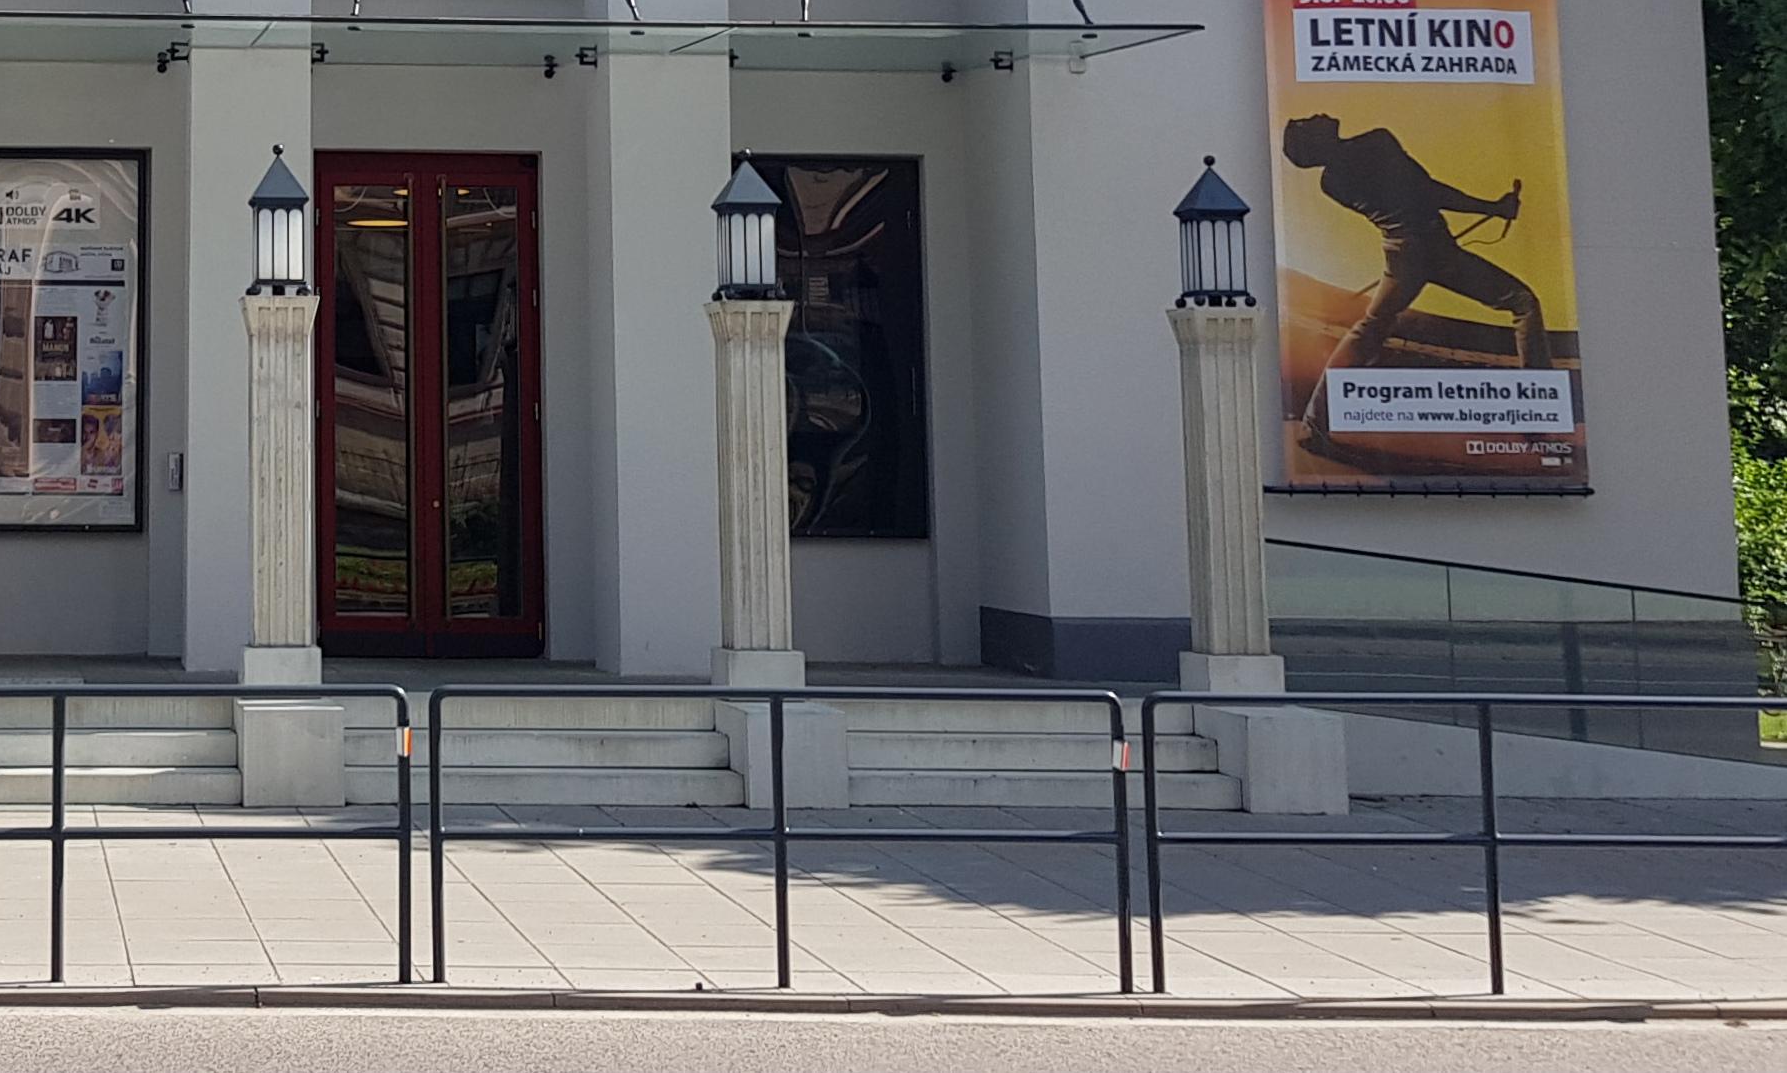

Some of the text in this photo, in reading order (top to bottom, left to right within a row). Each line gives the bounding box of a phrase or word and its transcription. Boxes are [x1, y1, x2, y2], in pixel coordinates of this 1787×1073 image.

[1310, 12, 1515, 49] LETNÍ KINO
[1311, 52, 1517, 74] ZÁMECKÁ ZAHRADA
[6, 206, 46, 217] DOLBY
[53, 208, 95, 224] 4K
[1343, 381, 1559, 403] Program letního kina
[1343, 408, 1559, 425] najdete na www.biografjicin.cz
[1486, 442, 1528, 454] DOLBY
